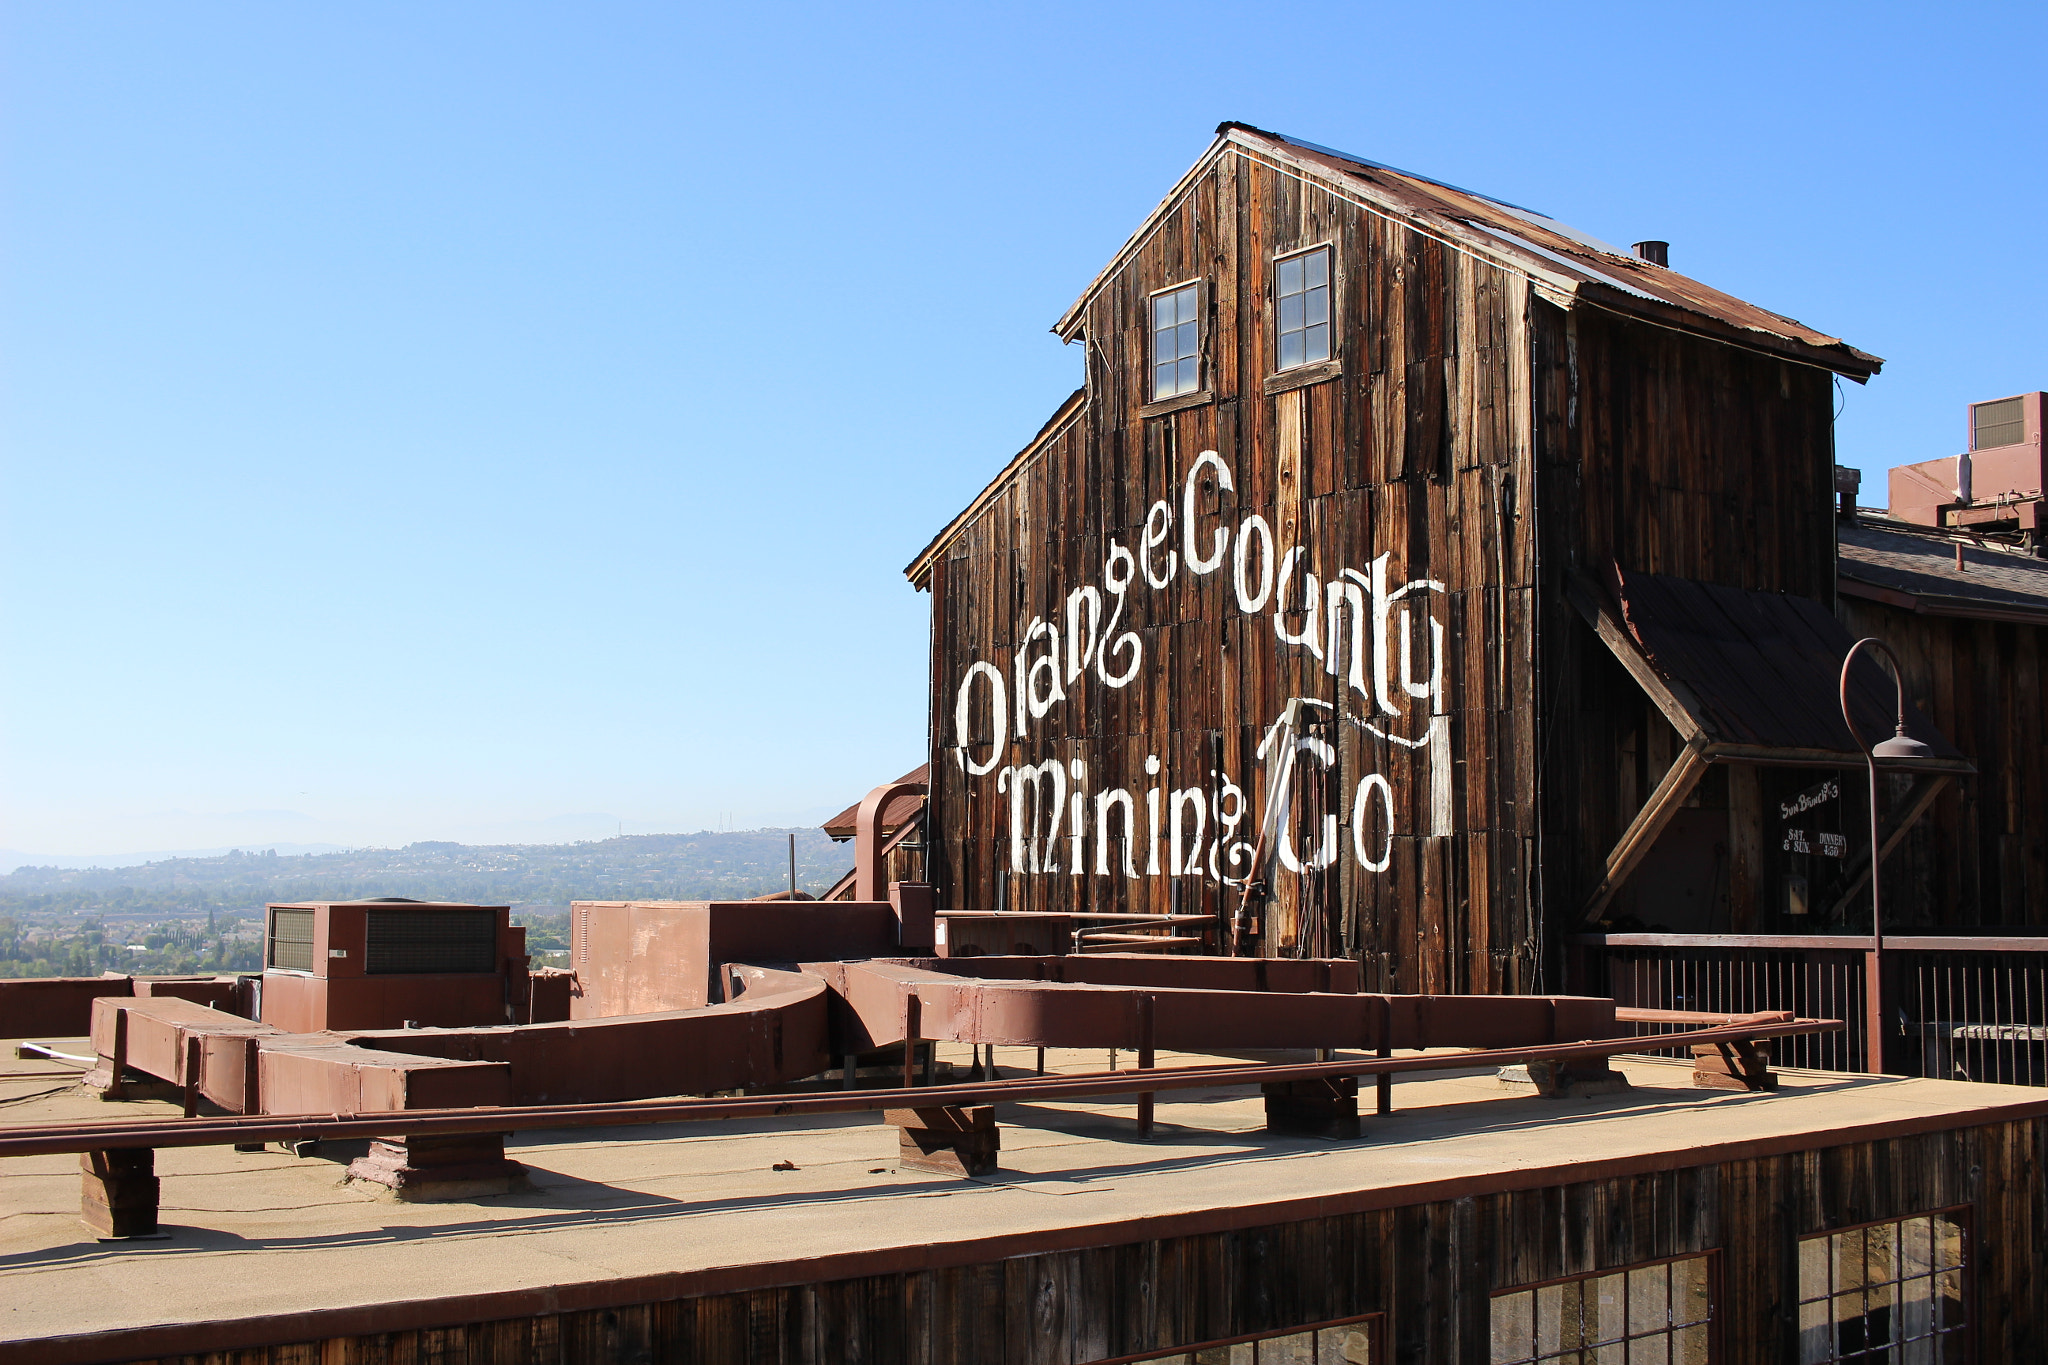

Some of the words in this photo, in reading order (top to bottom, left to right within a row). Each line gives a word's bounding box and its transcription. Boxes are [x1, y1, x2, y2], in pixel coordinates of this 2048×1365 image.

[955, 500, 1178, 776] Orange
[1183, 449, 1446, 749] County
[998, 755, 1260, 887] Mining
[1258, 698, 1394, 874] Co
[1788, 828, 1805, 841] SAT.
[1819, 832, 1843, 847] DINNER
[1783, 839, 1790, 851] &
